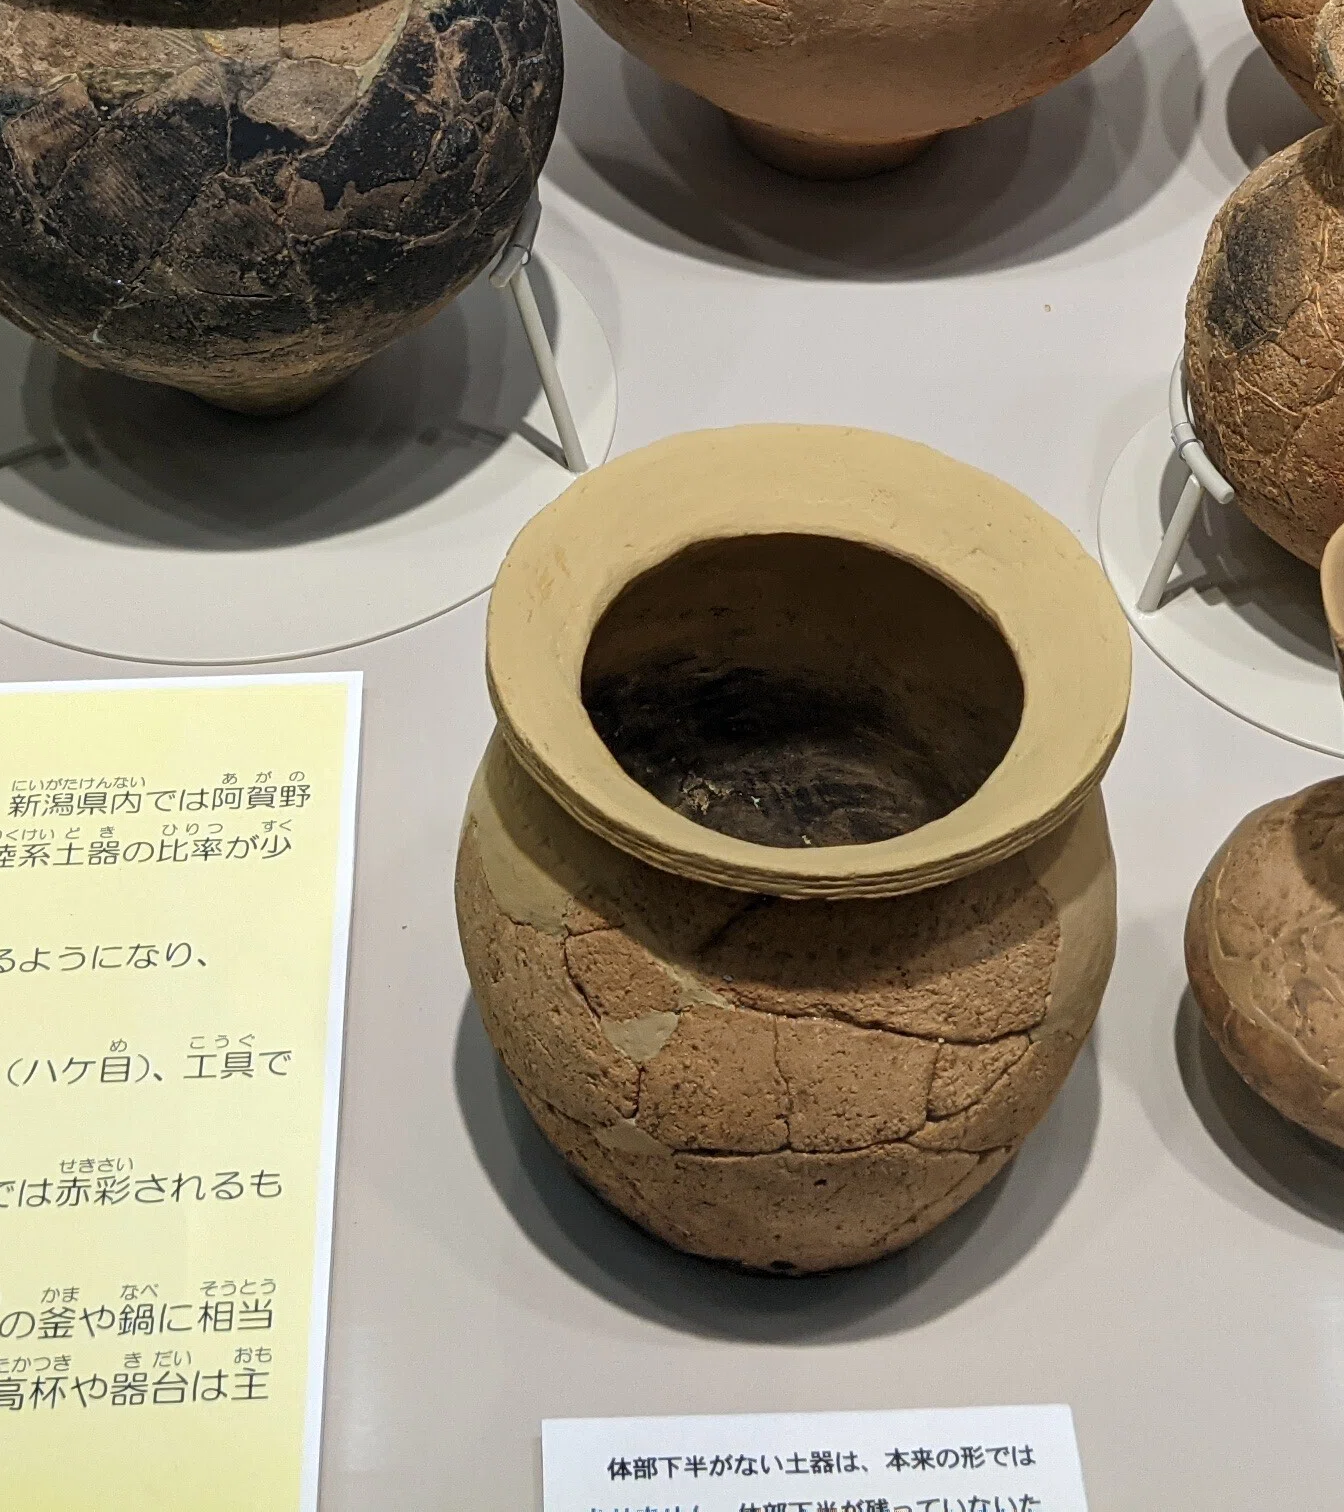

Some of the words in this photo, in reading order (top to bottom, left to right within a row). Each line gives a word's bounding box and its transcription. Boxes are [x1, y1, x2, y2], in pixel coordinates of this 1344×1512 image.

[606, 1444, 1036, 1482] 体部下半がない土器は、本来の形では
